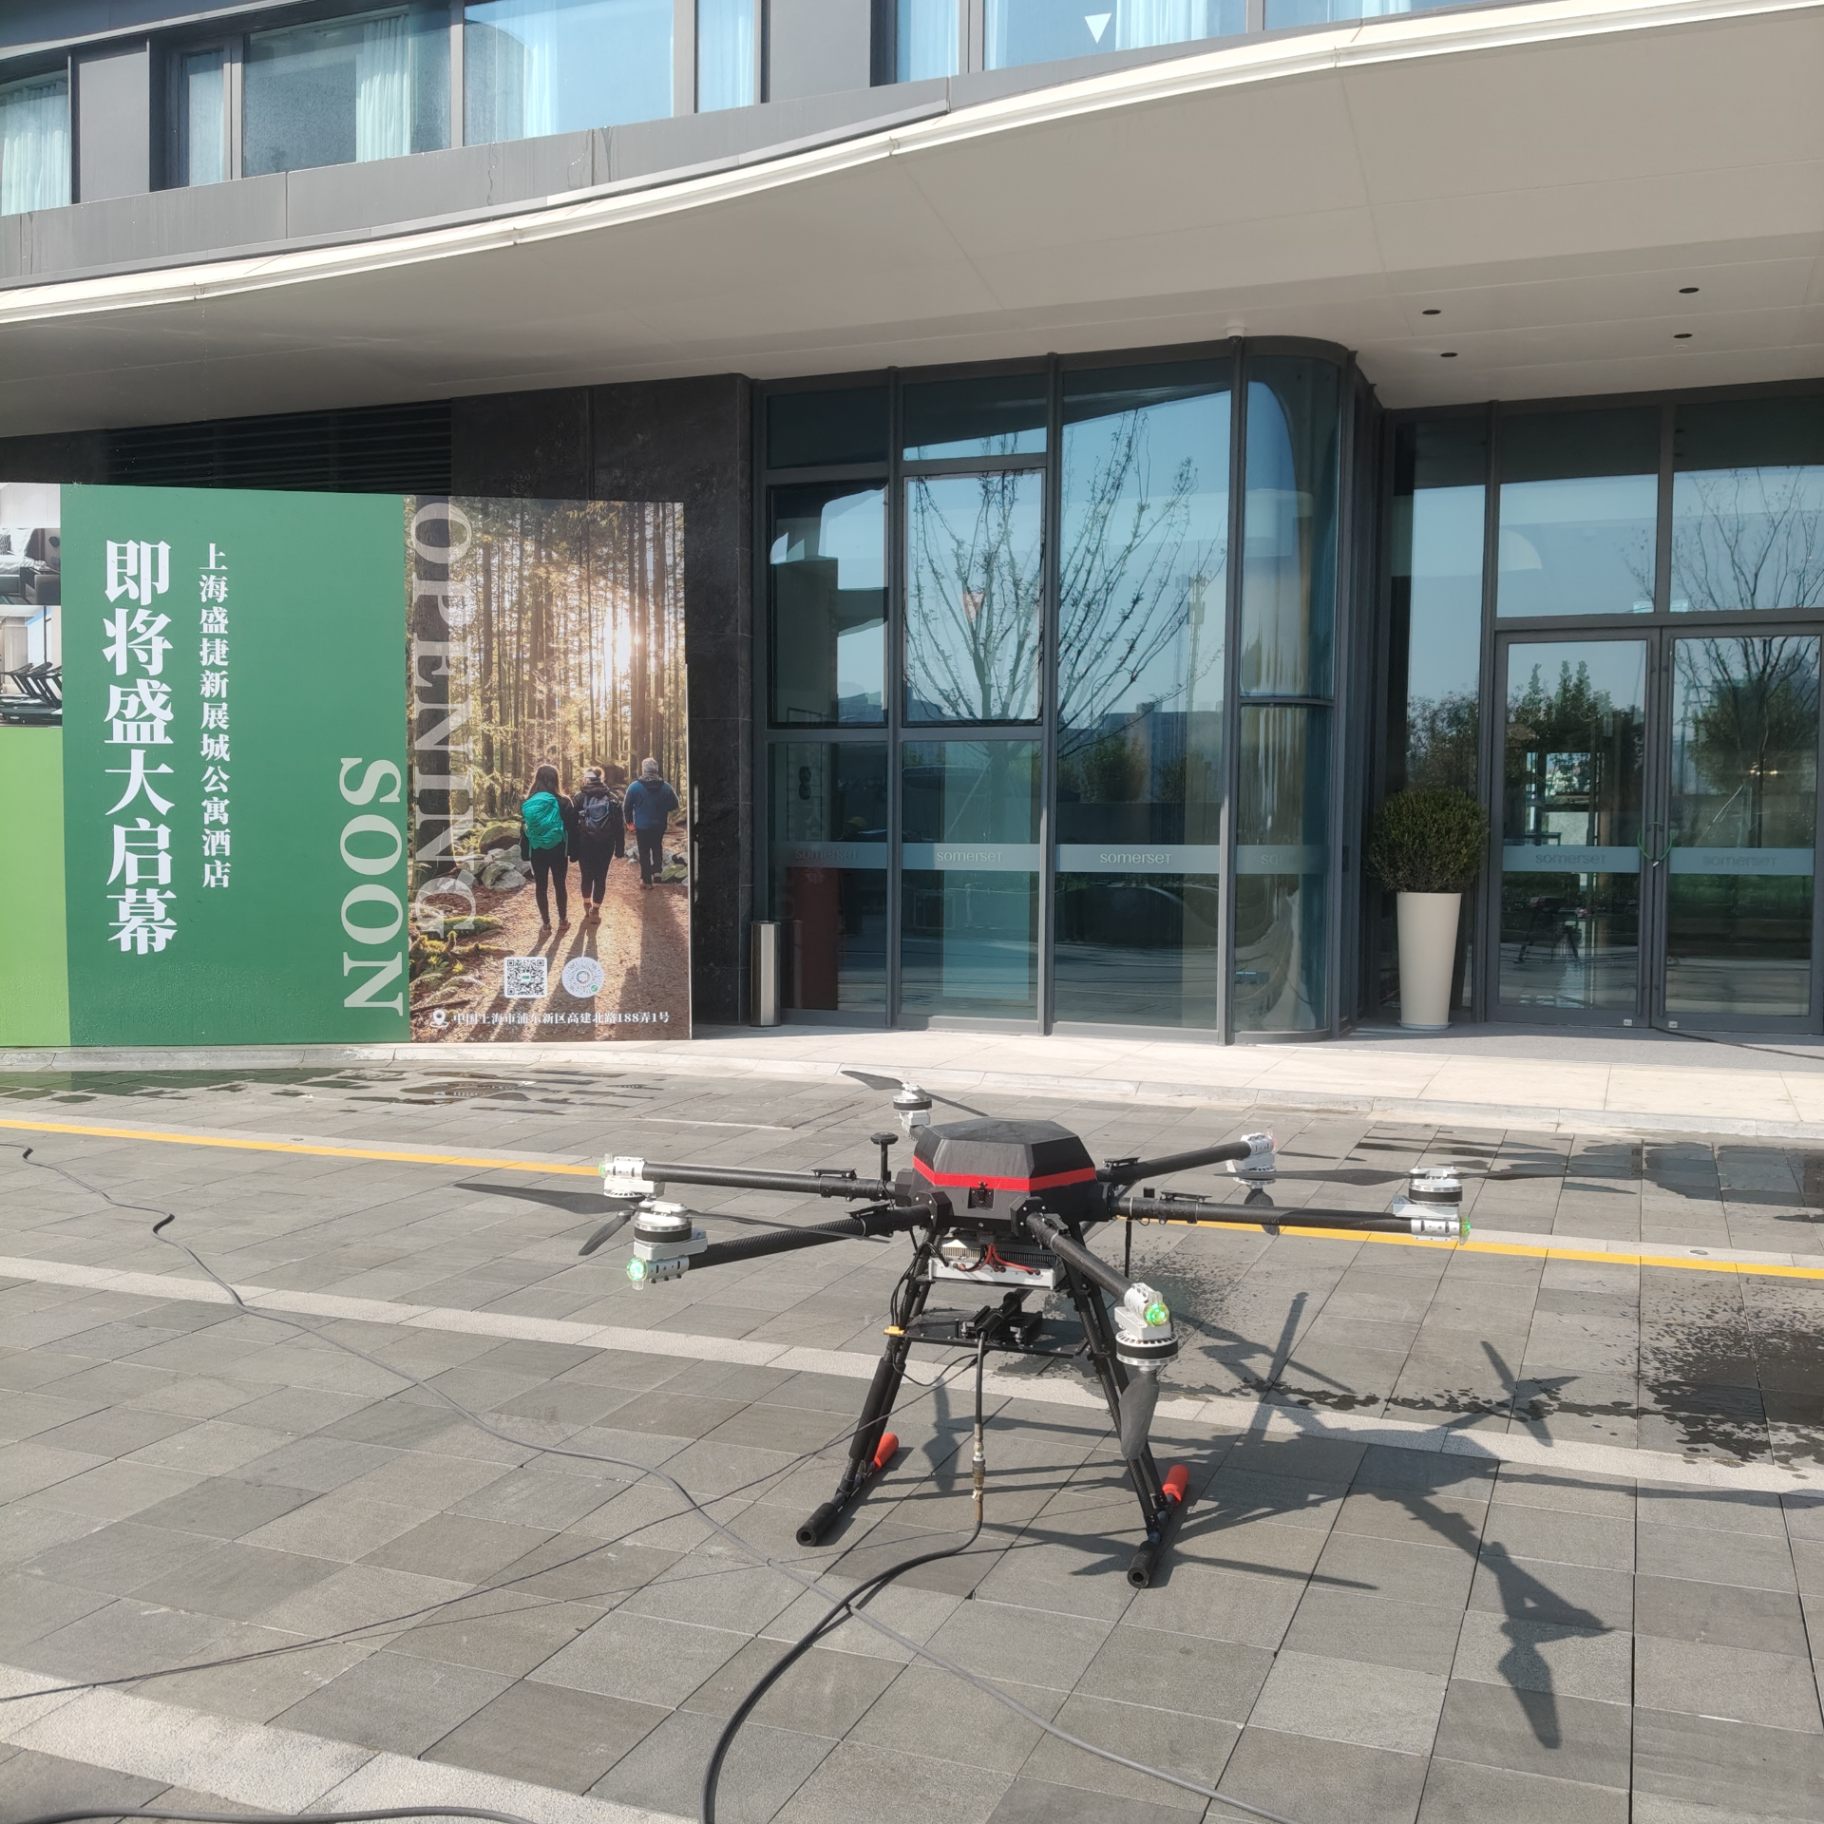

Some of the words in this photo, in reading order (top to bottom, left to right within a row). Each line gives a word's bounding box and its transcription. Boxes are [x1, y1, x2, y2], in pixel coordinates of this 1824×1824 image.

[102, 539, 177, 955] 即将盛大启幕
[199, 543, 231, 888] 上海盛捷新展城公寓酒店
[339, 757, 404, 1016] SOON
[411, 502, 476, 939] OPENING
[1100, 852, 1172, 864] somerset
